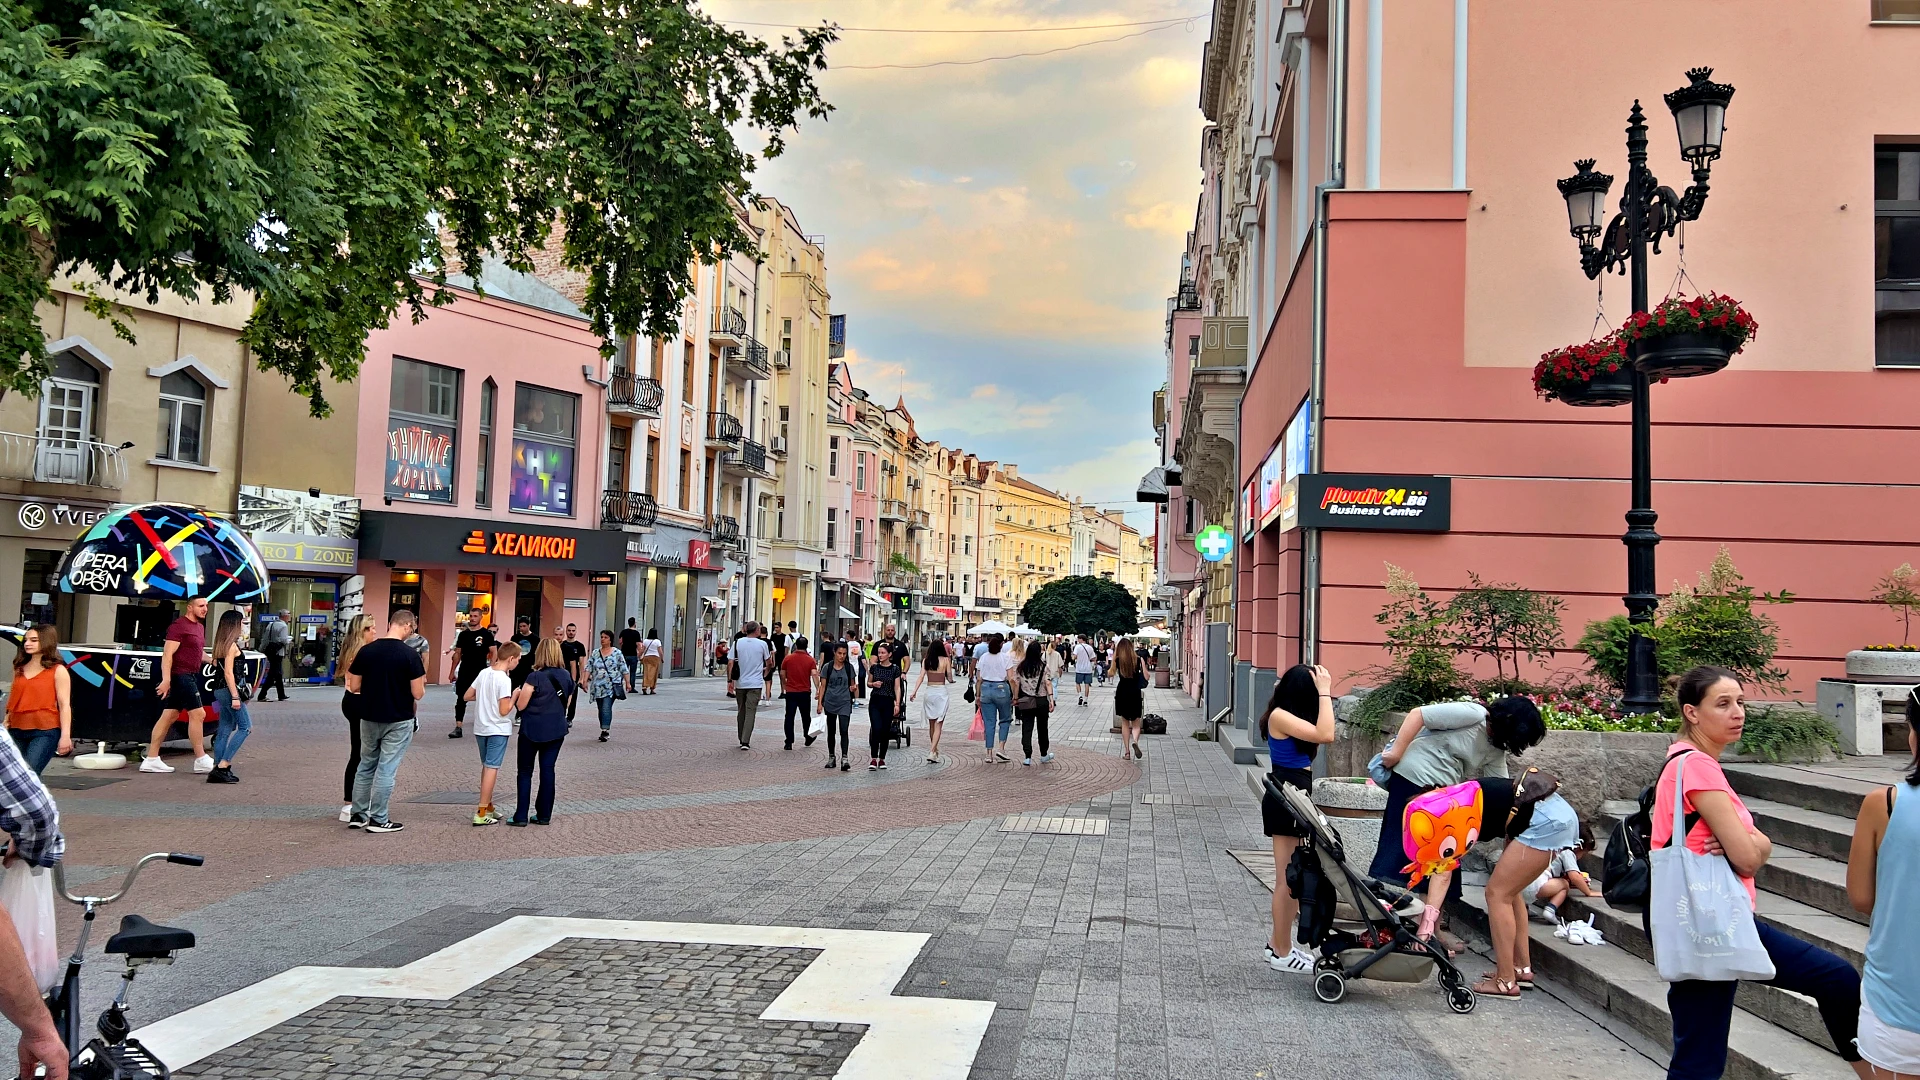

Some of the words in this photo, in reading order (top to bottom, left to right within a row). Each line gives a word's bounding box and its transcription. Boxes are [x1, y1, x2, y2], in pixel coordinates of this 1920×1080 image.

[391, 464, 443, 491] ХОРАТА
[1329, 505, 1380, 515] Business
[1383, 506, 1423, 516] Center
[294, 543, 304, 560] 1
[313, 549, 355, 564] ZONE
[491, 532, 576, 559] ХЕЛИКОН
[72, 550, 127, 572] OPERA
[71, 568, 120, 591] OPEN
[1704, 935, 1723, 947] Be
